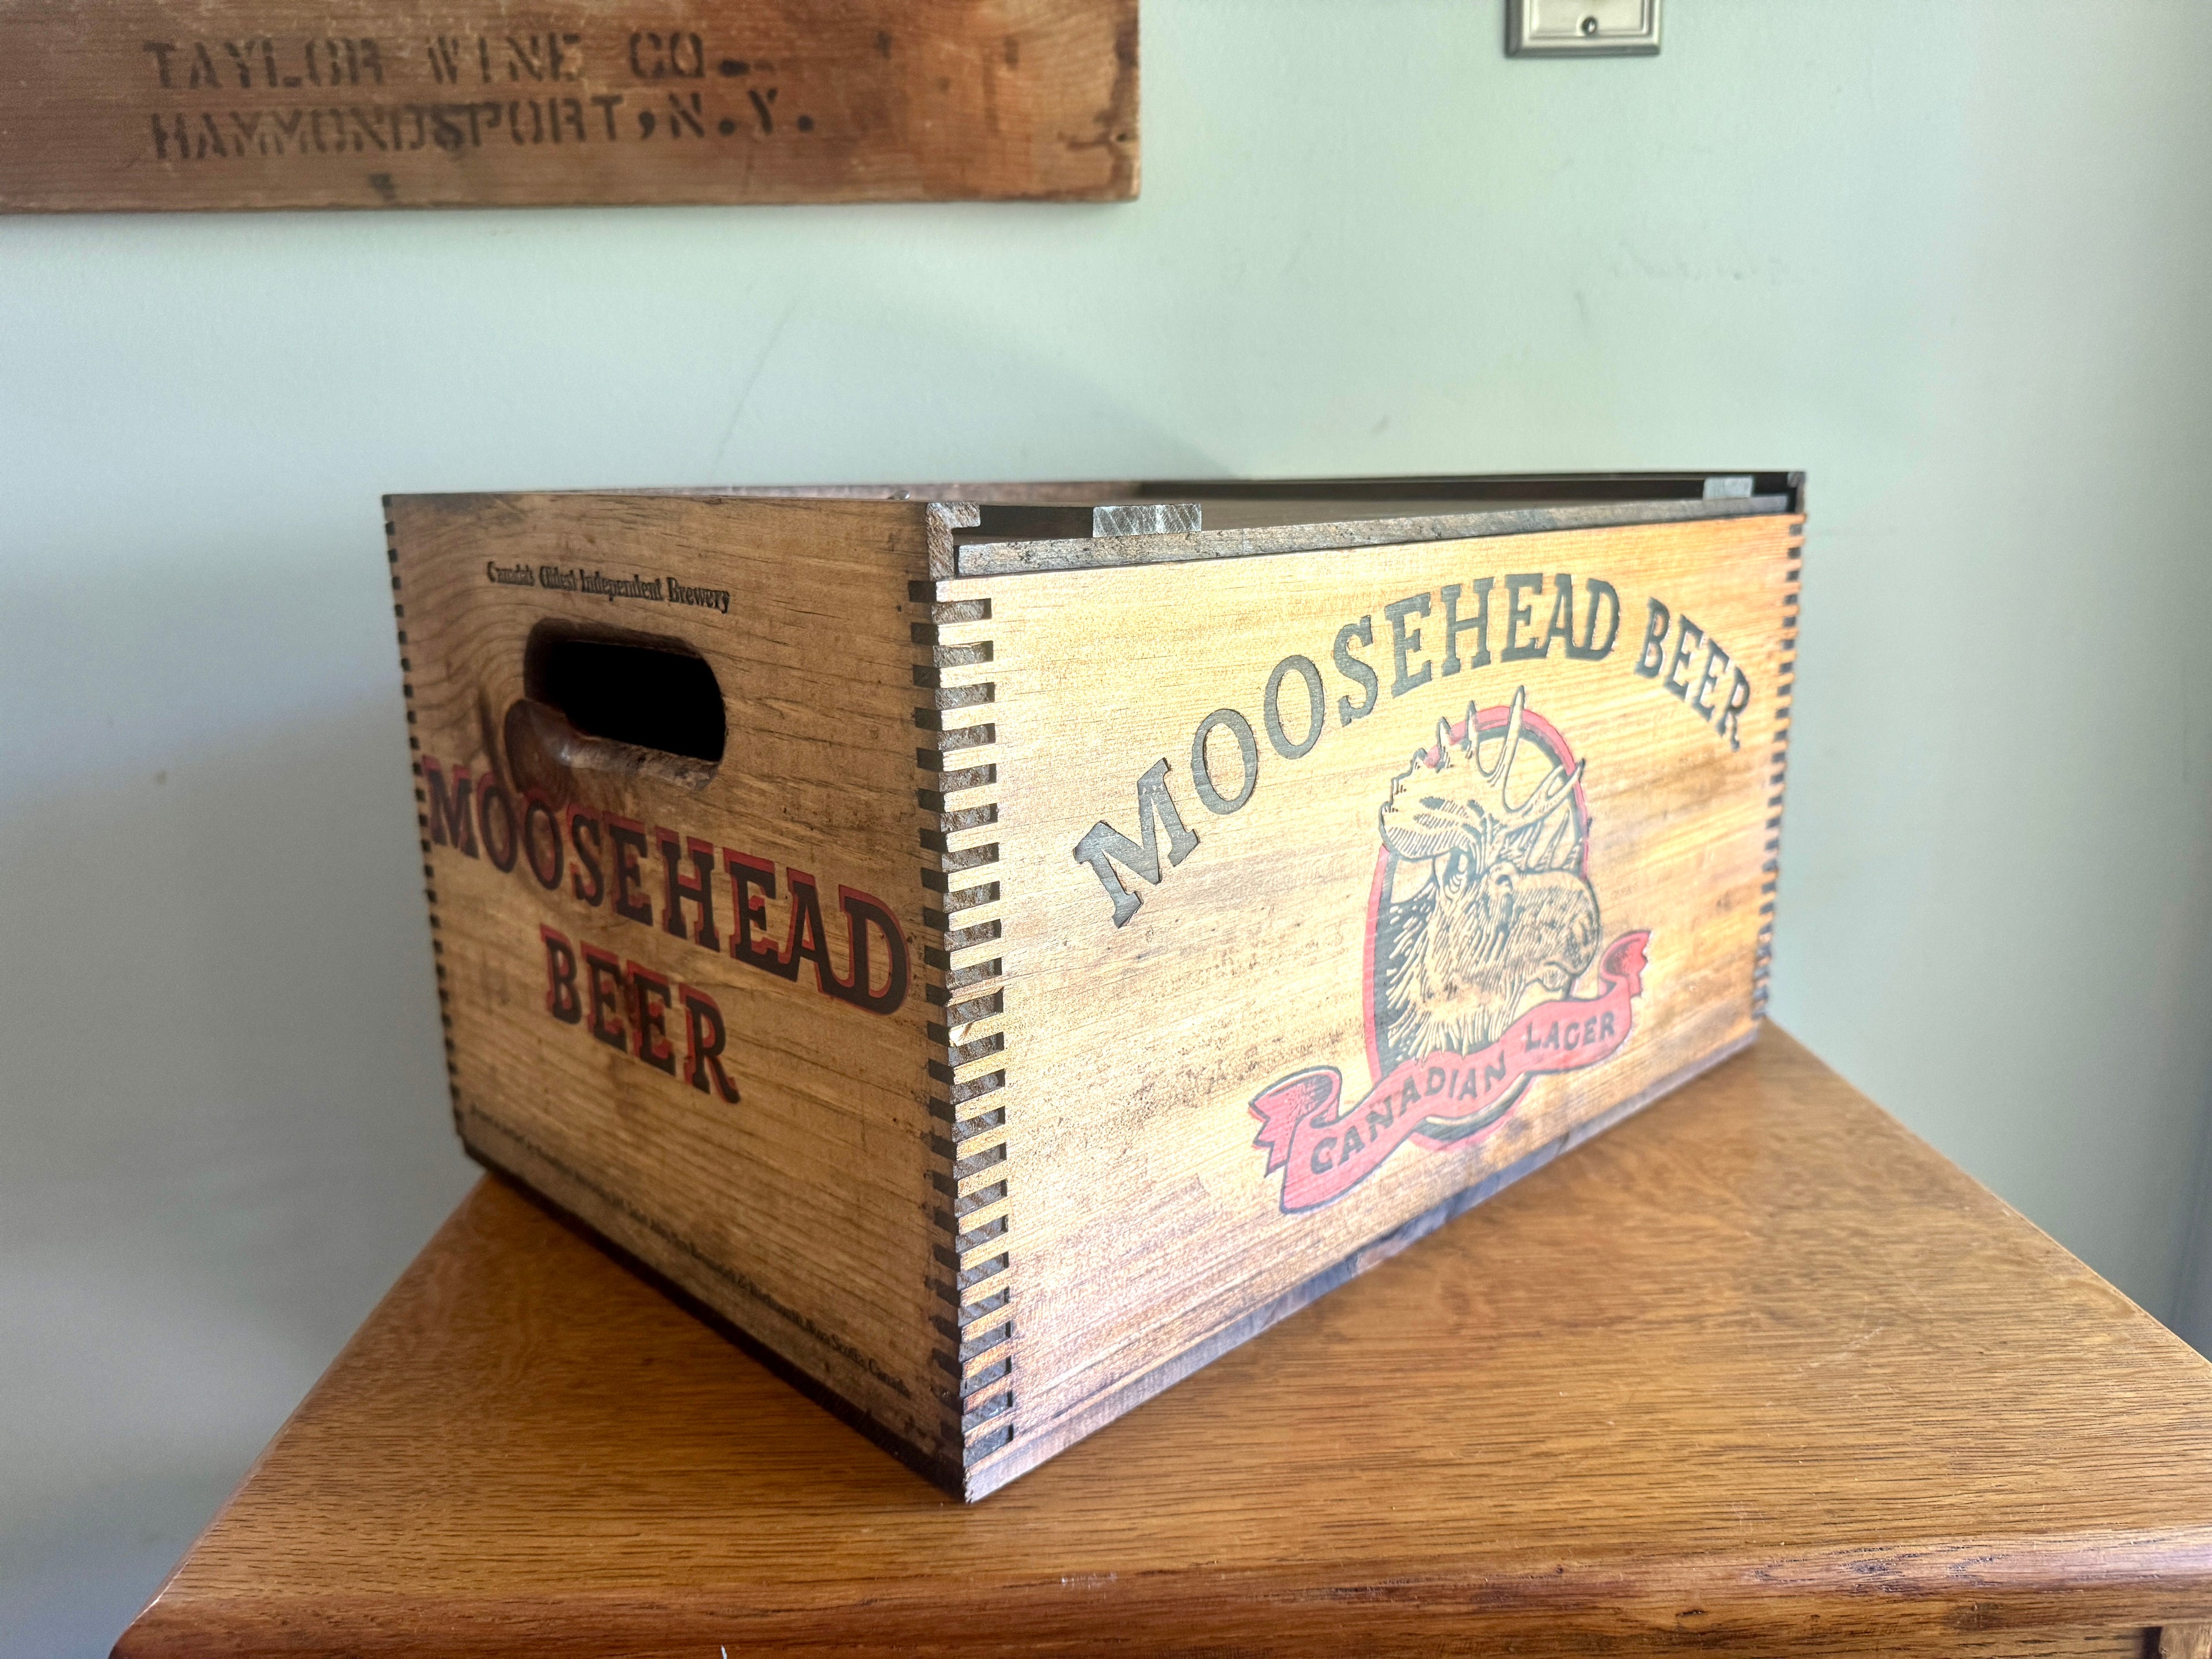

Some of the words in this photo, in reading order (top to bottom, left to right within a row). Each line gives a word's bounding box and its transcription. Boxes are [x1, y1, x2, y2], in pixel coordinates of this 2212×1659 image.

[143, 37, 383, 89] TAYLOR
[425, 32, 581, 84] WINE
[579, 569, 664, 601] Independent
[666, 577, 730, 614] Brewery
[1073, 573, 1621, 929] MOOSEHEAD
[1634, 596, 1751, 751] BEER
[421, 755, 912, 1016] MOOSEHEAD
[540, 923, 741, 1104] BEER
[1310, 1052, 1507, 1175] CANADIAN
[1524, 1010, 1615, 1053] LAGER
